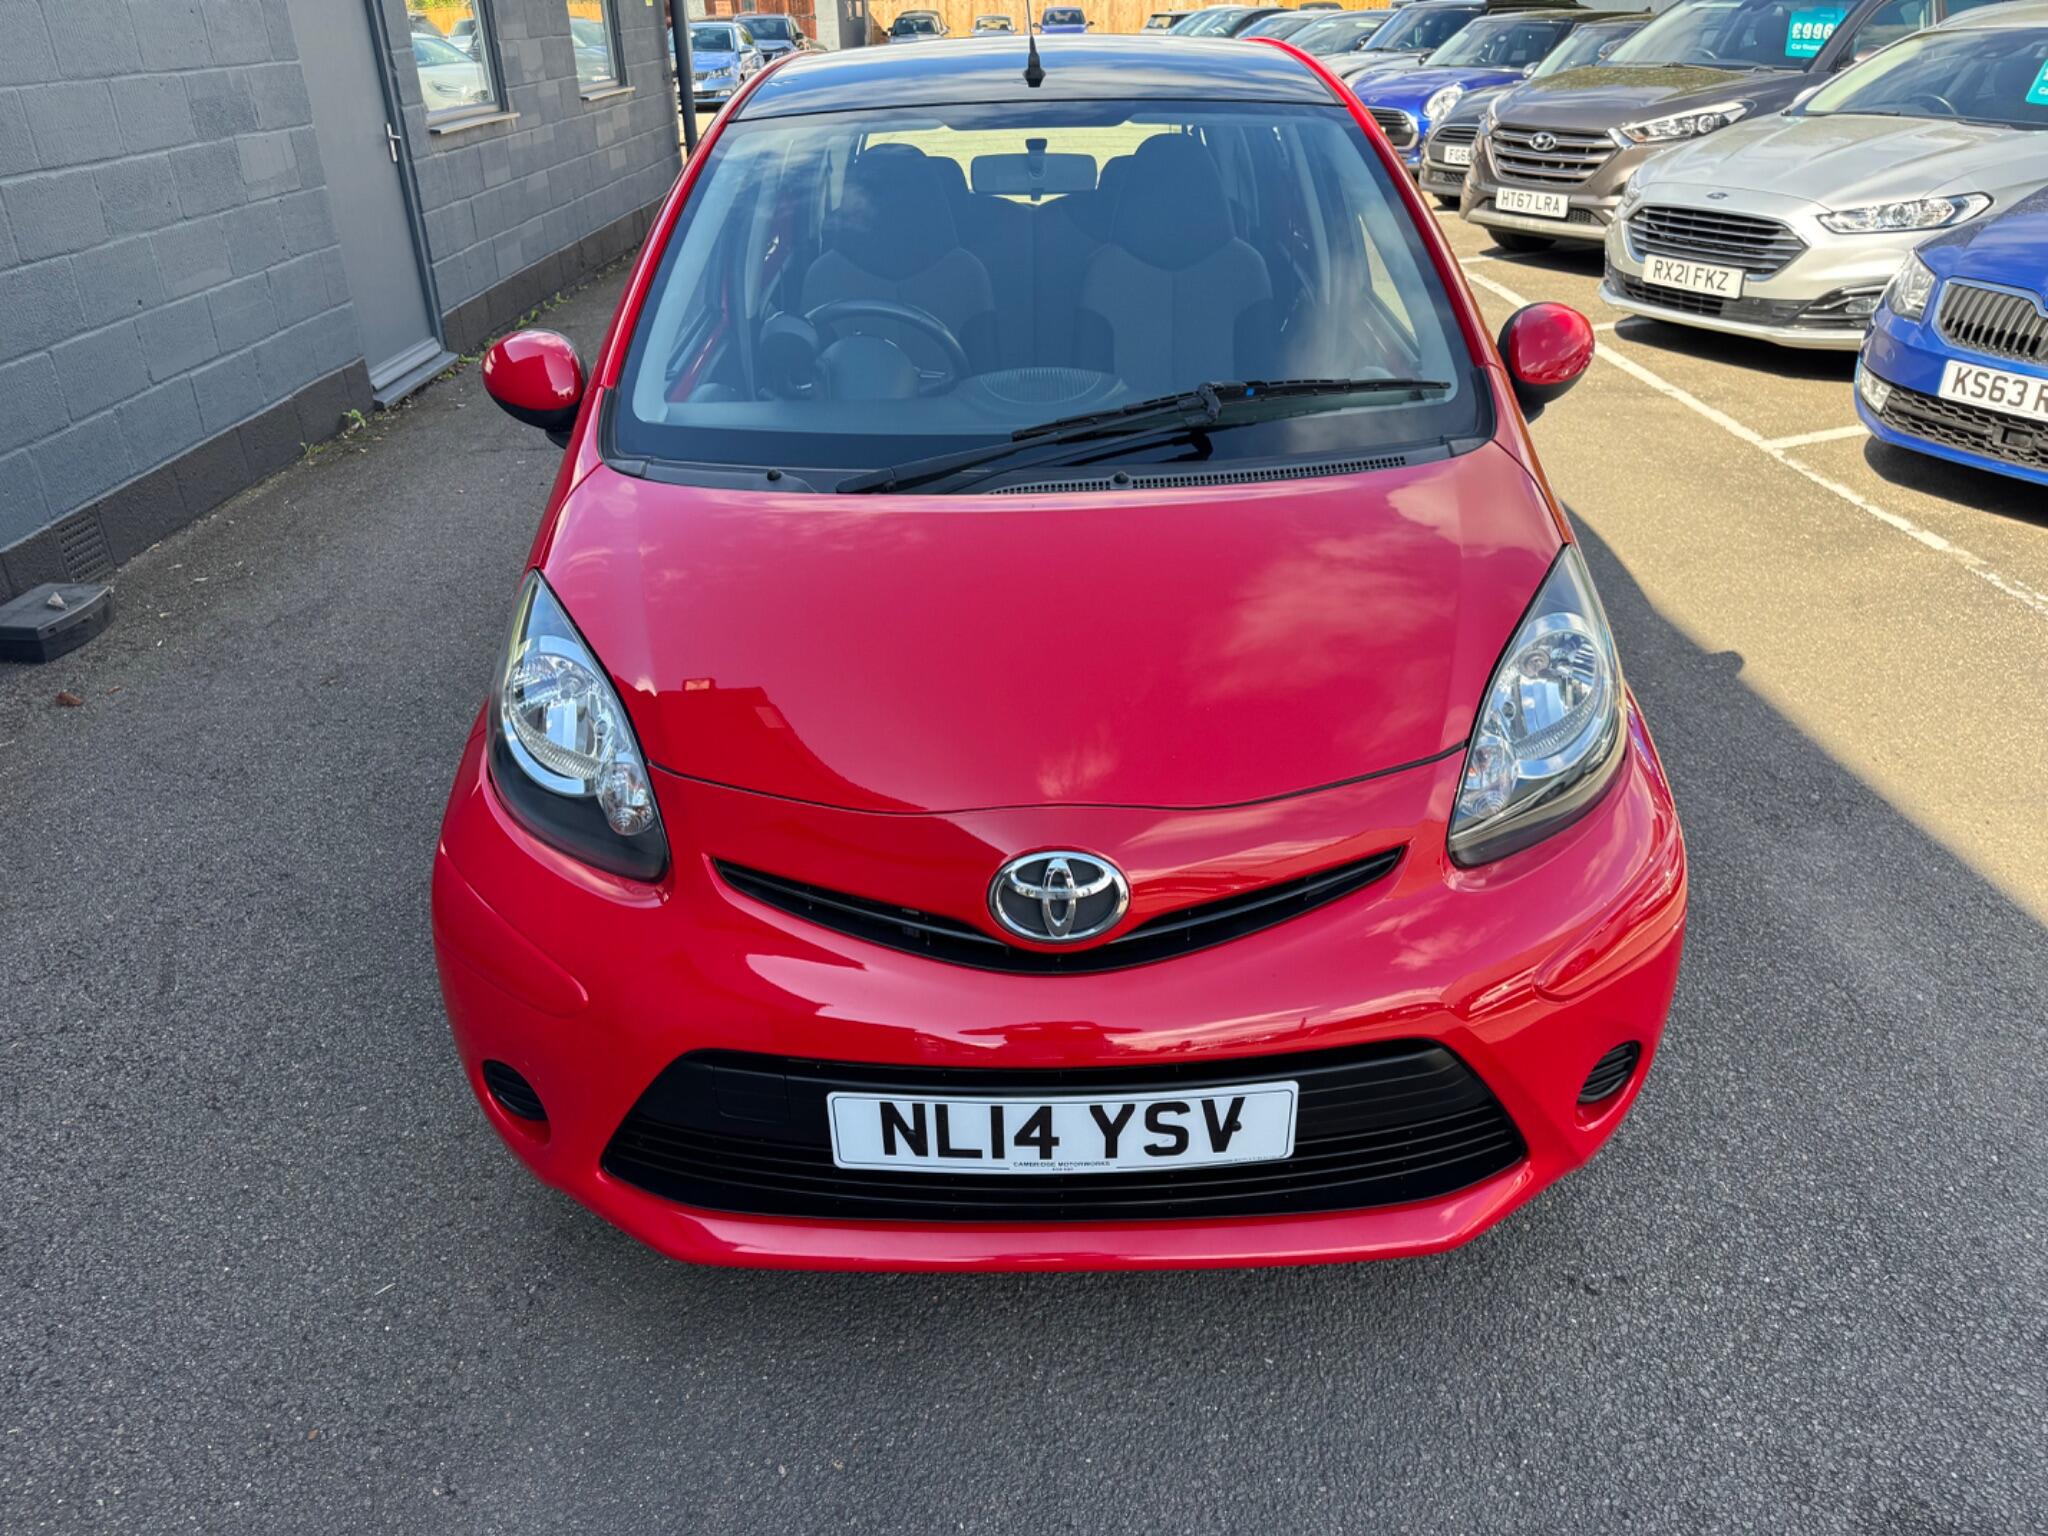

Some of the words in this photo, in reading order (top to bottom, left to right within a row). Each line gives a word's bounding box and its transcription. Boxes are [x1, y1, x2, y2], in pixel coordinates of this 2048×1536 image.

[1501, 191, 1532, 209] HT67
[1535, 195, 1560, 213] LRA
[1653, 260, 1690, 285] RX21
[1693, 267, 1729, 291] FKZ
[1952, 366, 2029, 407] KS63
[880, 1101, 1060, 1160] NL14
[1089, 1096, 1246, 1160] YSV
